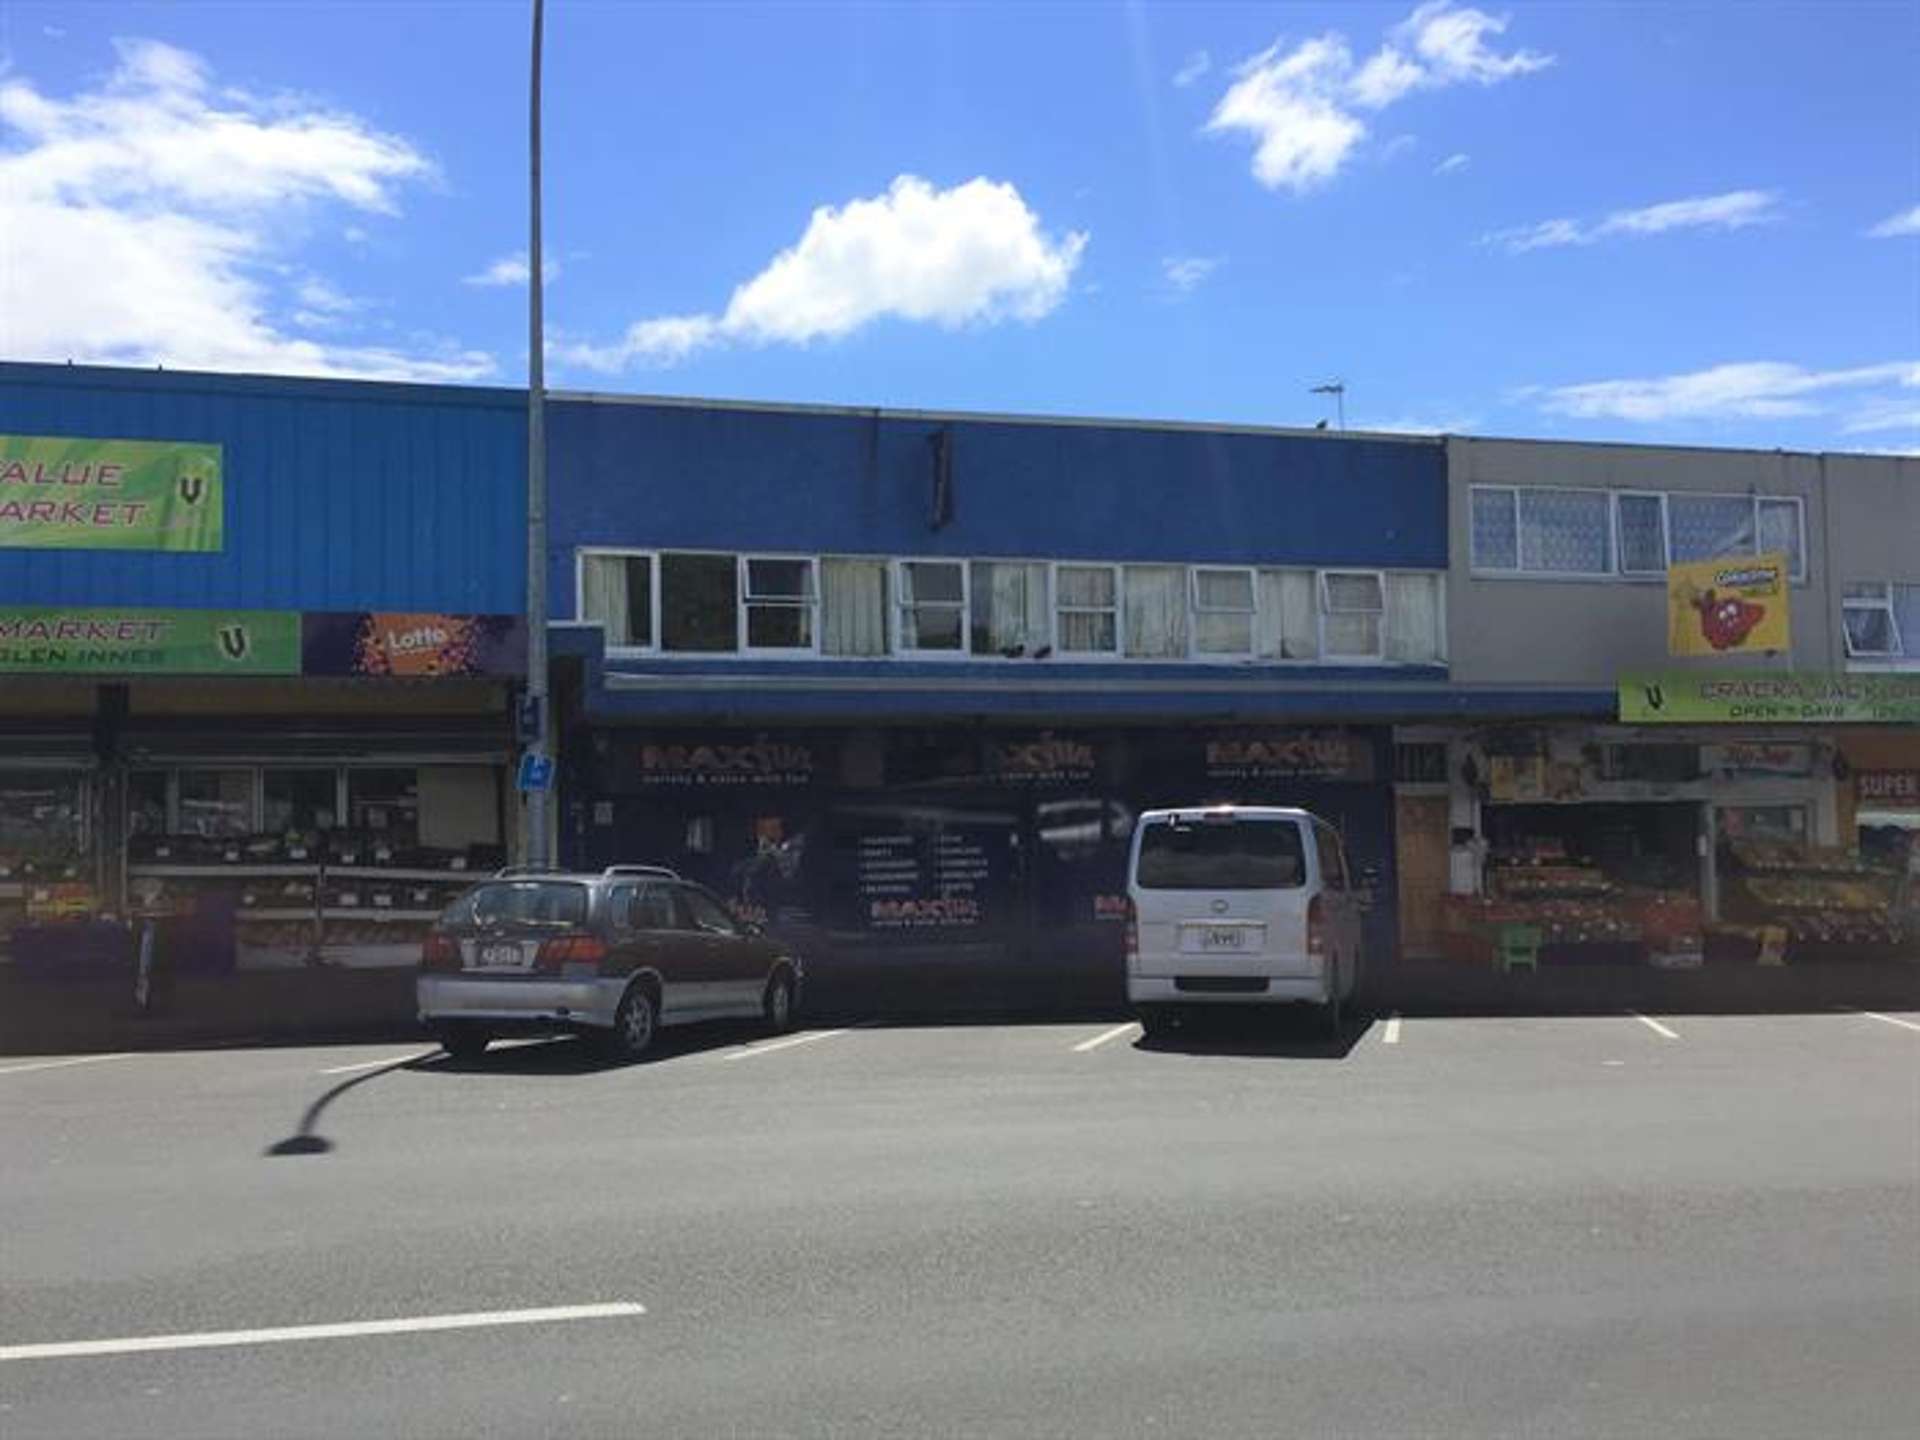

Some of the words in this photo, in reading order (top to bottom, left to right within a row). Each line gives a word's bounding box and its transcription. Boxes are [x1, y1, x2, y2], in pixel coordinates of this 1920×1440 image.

[0, 460, 121, 486] ALUE
[0, 501, 145, 525] ARKET
[387, 627, 448, 649] Lotto
[1729, 703, 1779, 718] OPEN
